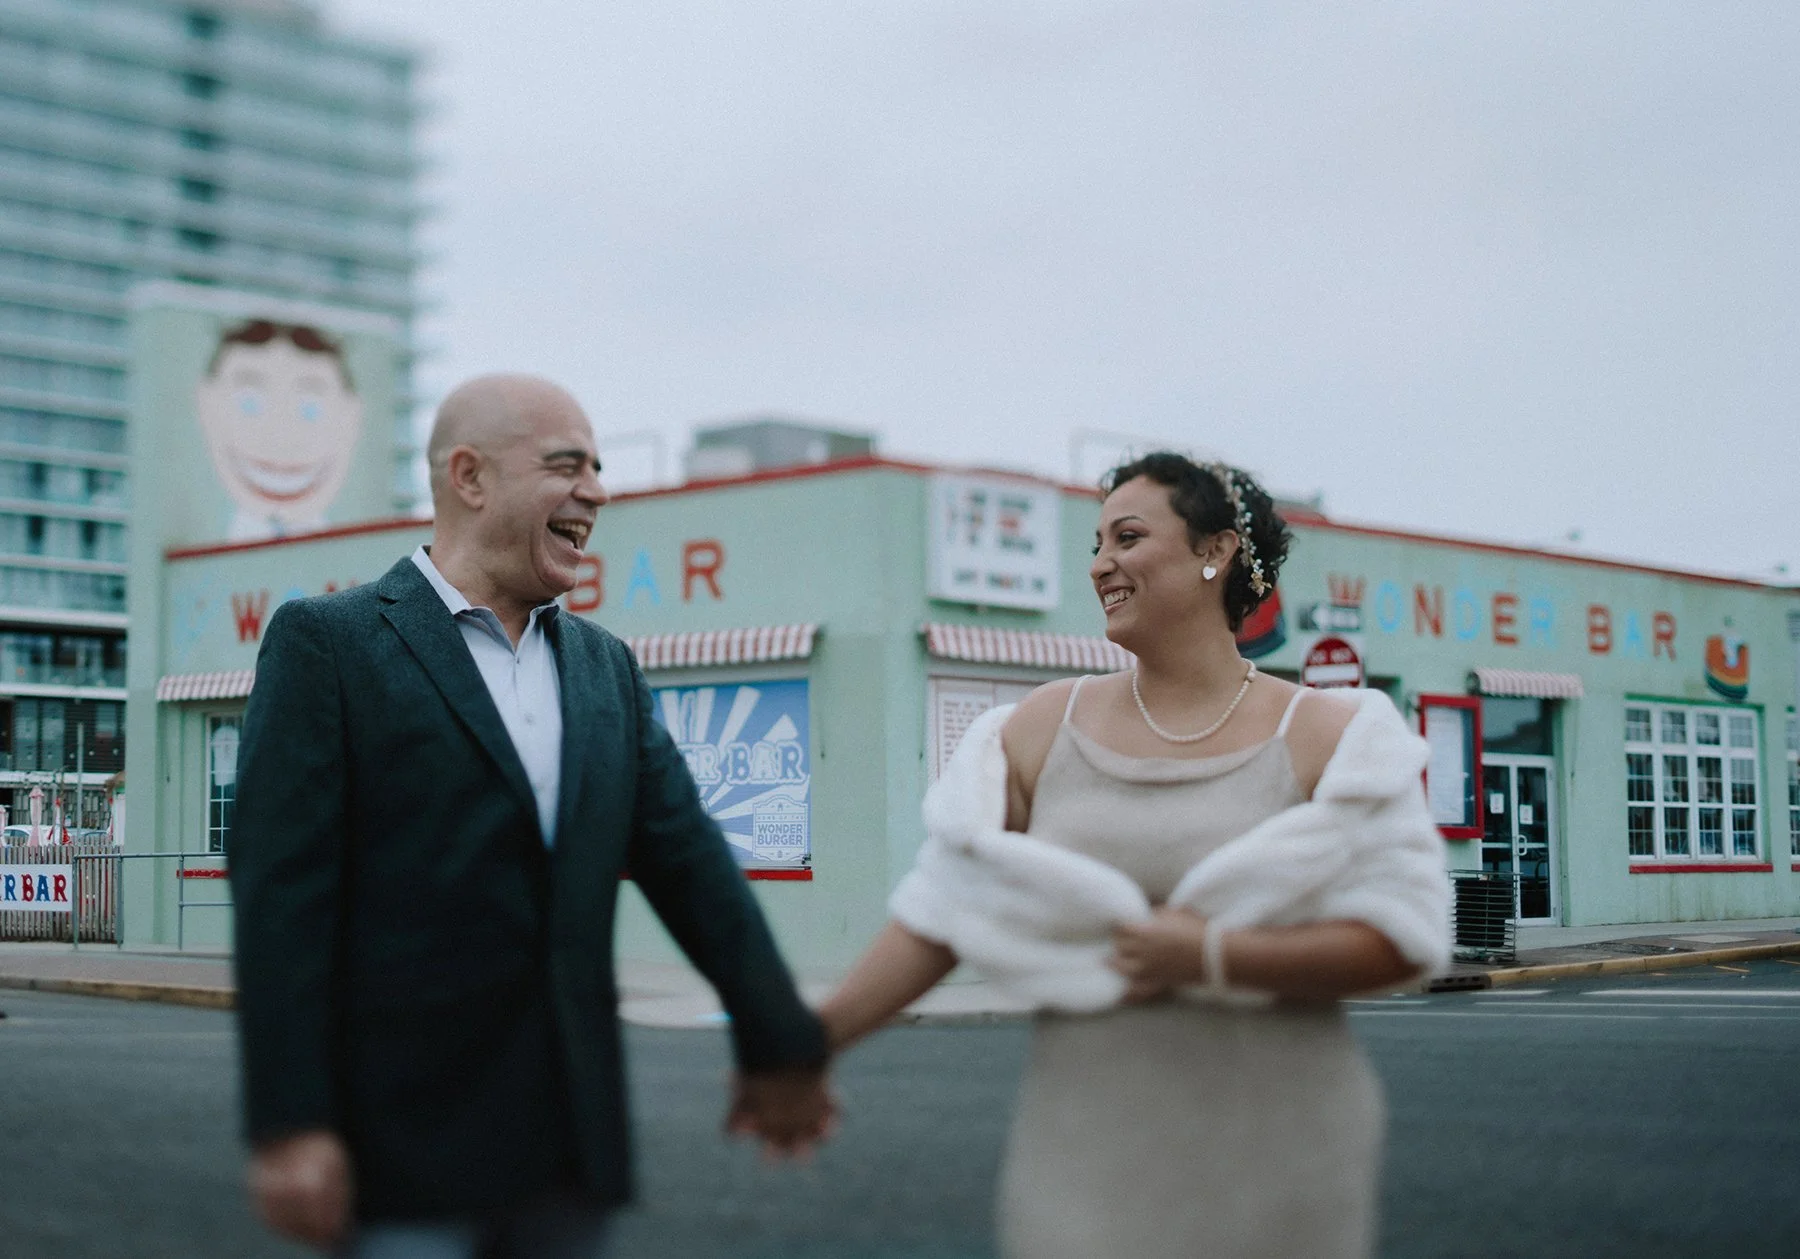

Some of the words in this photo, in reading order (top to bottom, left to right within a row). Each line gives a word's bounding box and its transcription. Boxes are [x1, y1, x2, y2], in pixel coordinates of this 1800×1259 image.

[567, 539, 725, 612] BAR
[1326, 571, 1558, 650] WONDER
[1587, 603, 1678, 663] BAR
[726, 741, 807, 784] BAR
[757, 823, 803, 834] WONDER
[757, 834, 803, 845] BURGER
[21, 873, 68, 902] BAR
